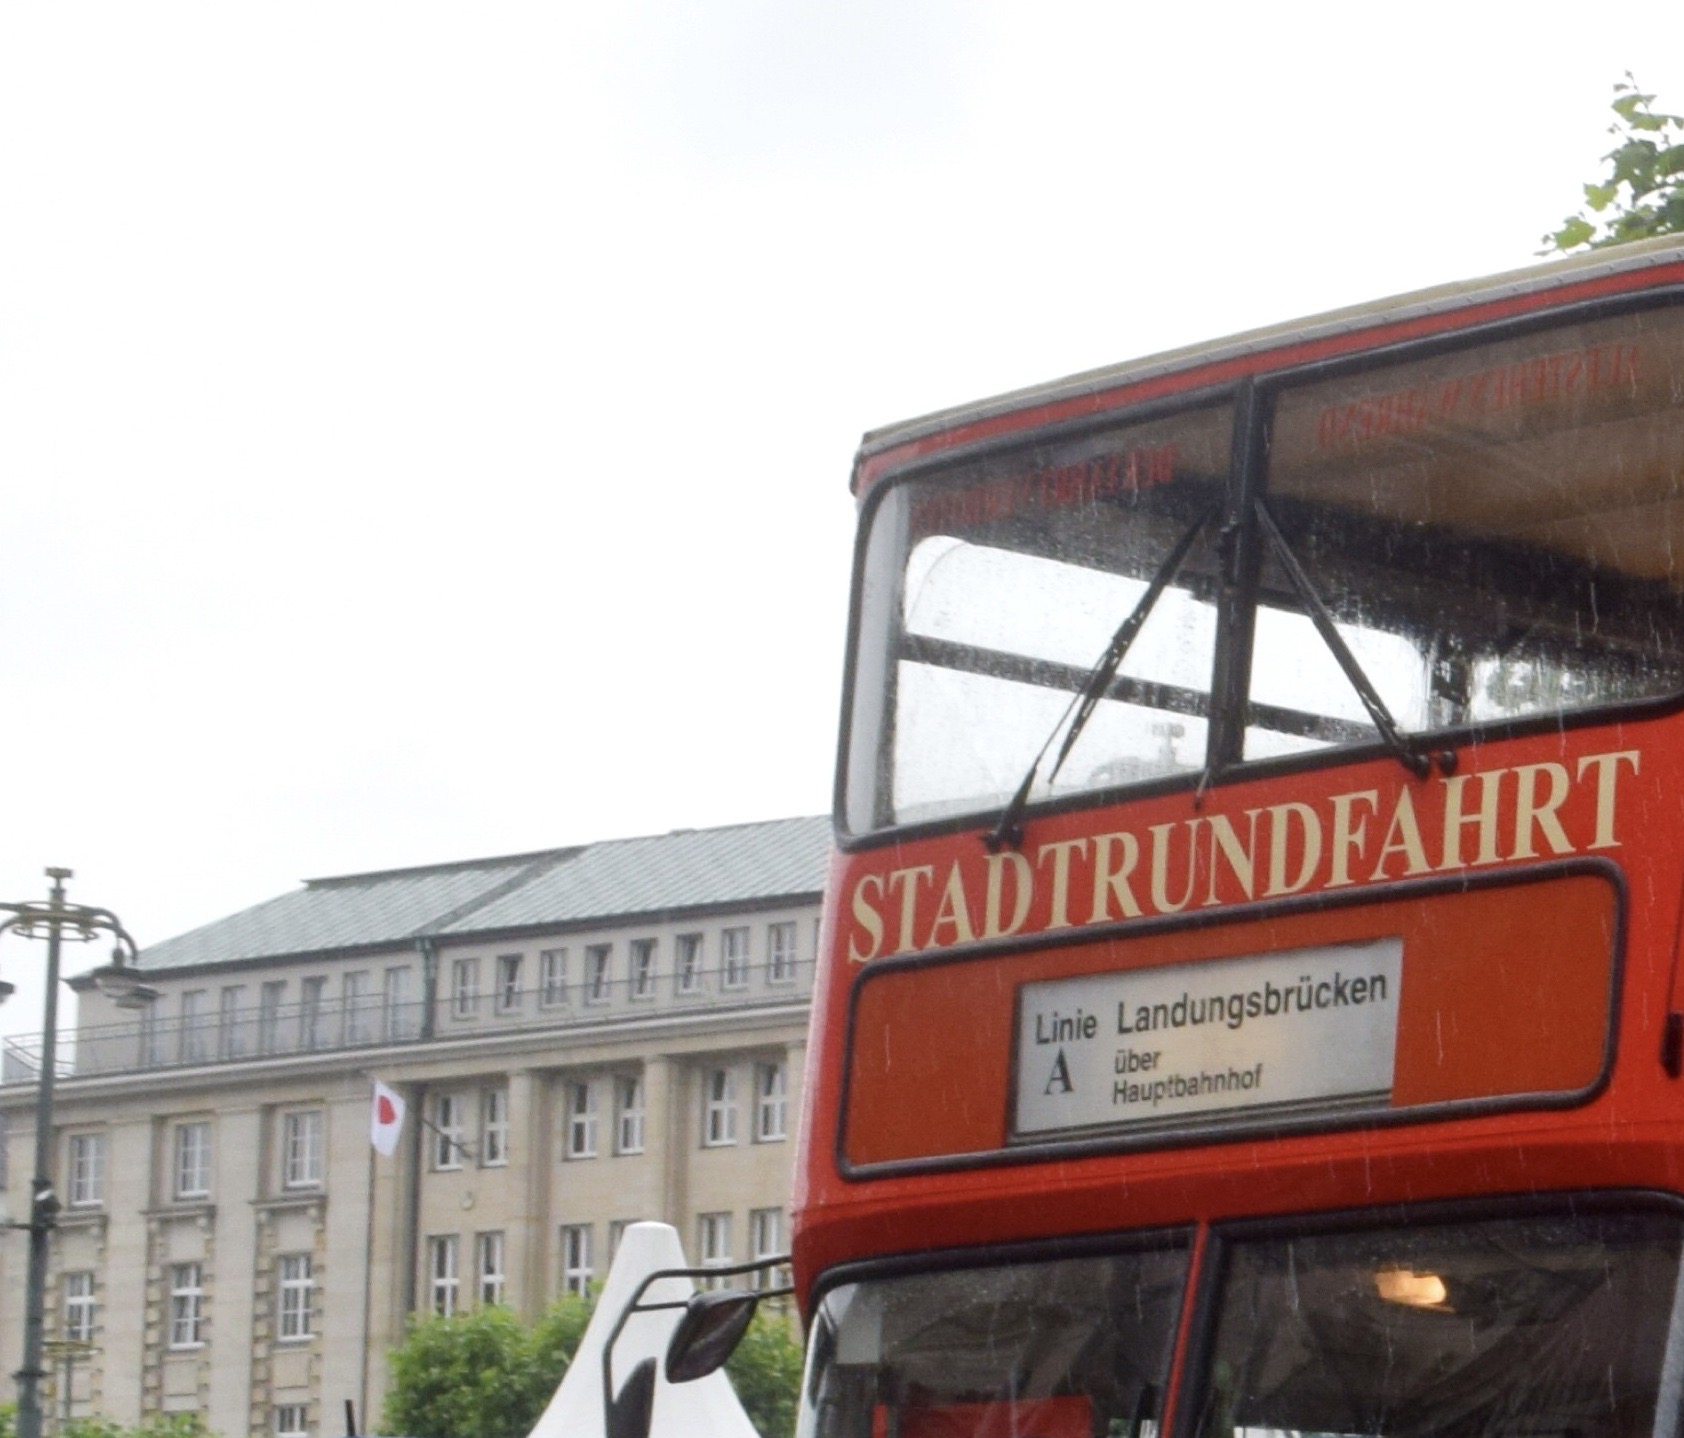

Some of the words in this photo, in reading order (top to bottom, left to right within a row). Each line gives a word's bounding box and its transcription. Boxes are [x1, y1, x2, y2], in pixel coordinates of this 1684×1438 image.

[848, 750, 1641, 963] STADTRUNDFAHRT
[1036, 1008, 1097, 1044] Linie
[1117, 973, 1386, 1035] Landungsbrücken
[1044, 1048, 1073, 1095] A
[1113, 1063, 1262, 1106] Hauptbahnhof
[1114, 1049, 1161, 1075] über
